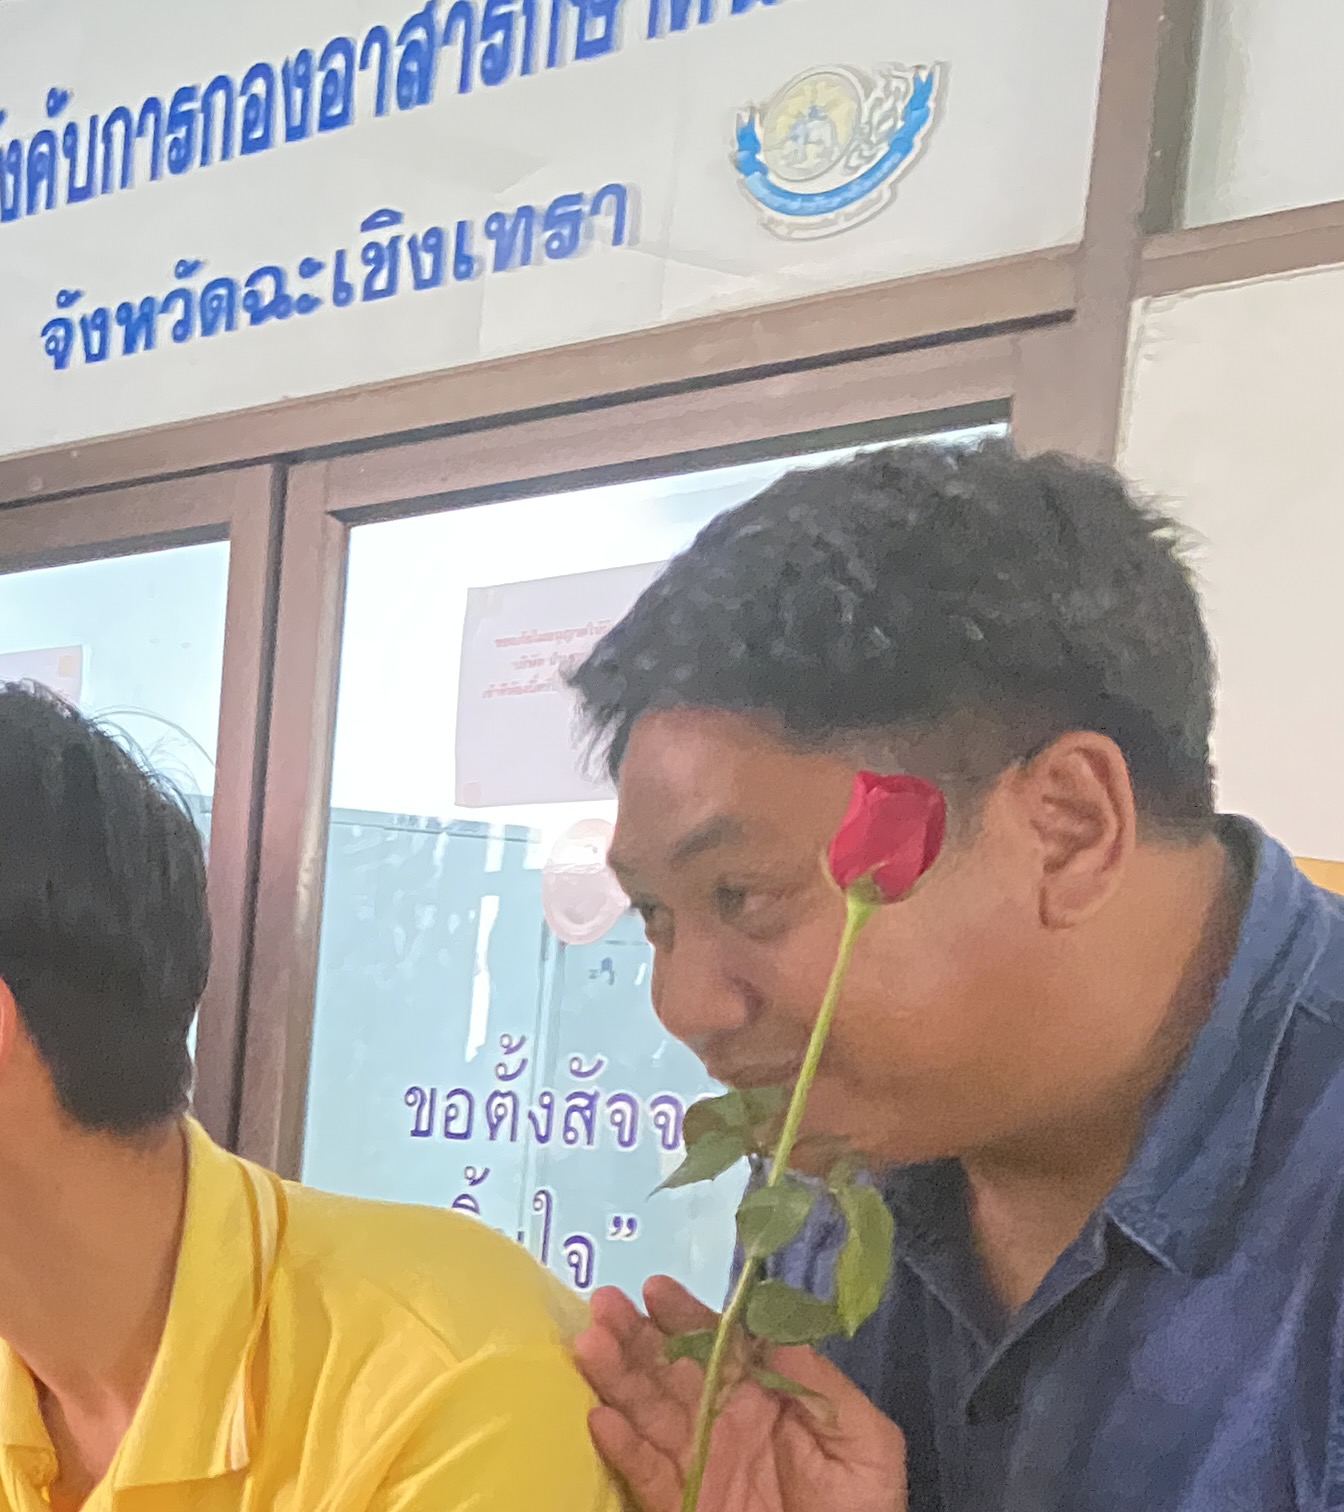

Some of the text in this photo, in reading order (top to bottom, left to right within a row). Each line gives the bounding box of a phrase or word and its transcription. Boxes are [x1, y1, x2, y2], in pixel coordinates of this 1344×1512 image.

[40, 182, 630, 370] จังหวัดฉะเชิงเทรา
[404, 1033, 685, 1150] ขอตั้งสัจจ
